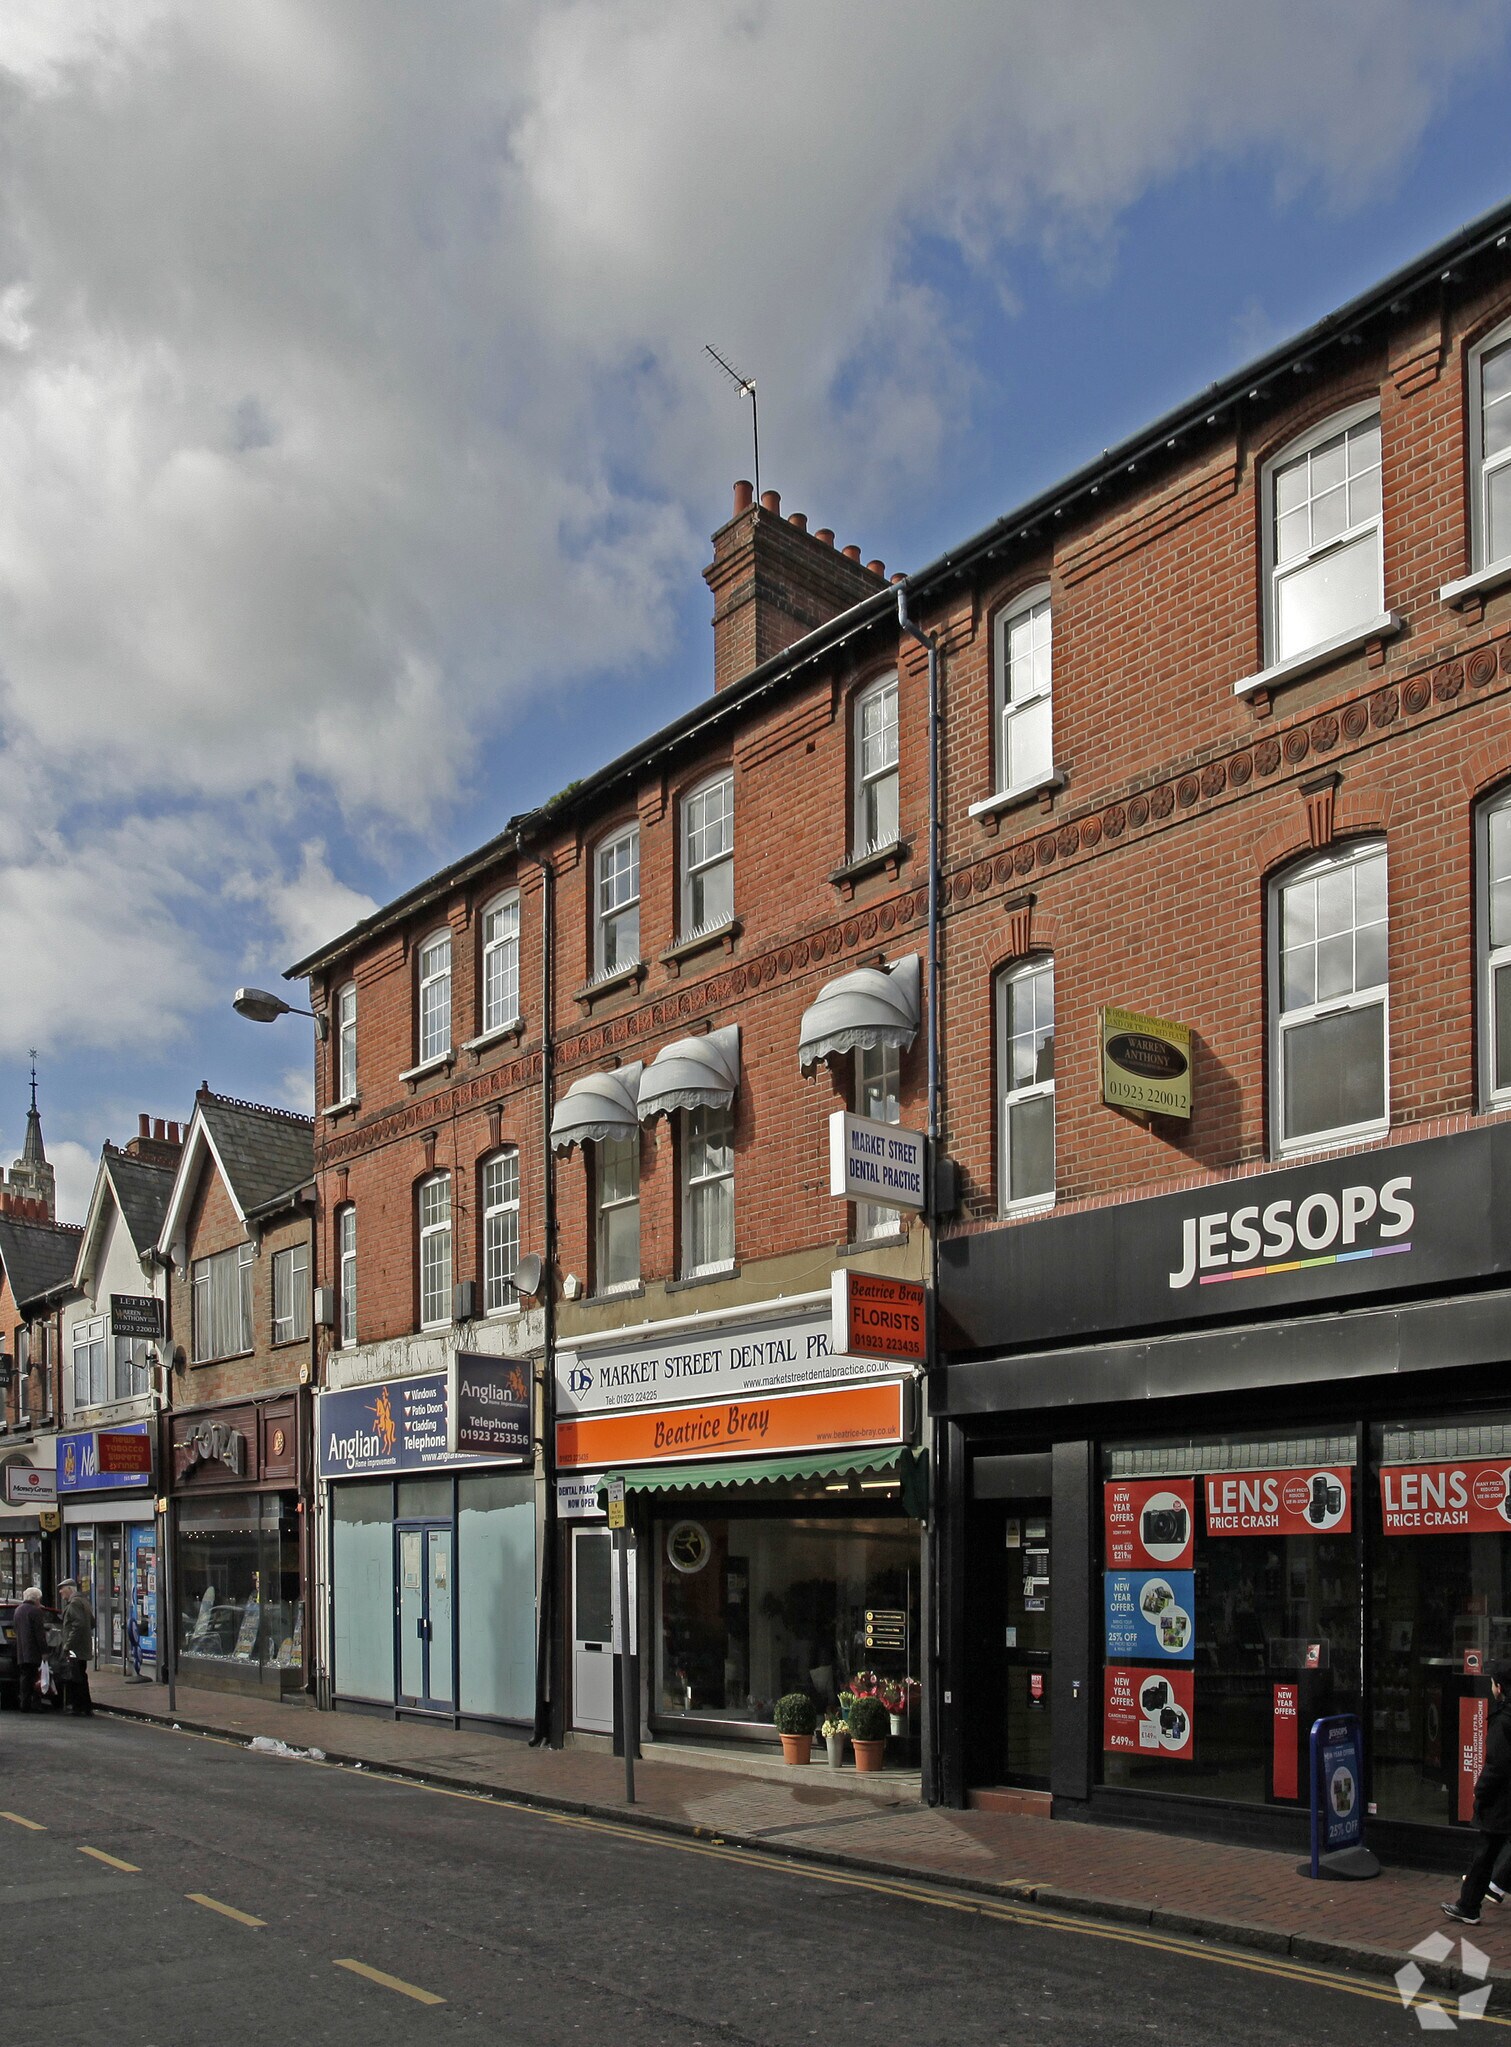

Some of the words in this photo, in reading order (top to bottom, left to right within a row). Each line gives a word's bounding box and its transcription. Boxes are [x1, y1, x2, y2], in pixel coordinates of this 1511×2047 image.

[1108, 1018, 1124, 1027] AND
[1134, 1023, 1149, 1033] TWO
[1155, 1027, 1168, 1037] BED
[1168, 1030, 1186, 1041] FLATS
[1130, 1012, 1160, 1026] BUILDING
[1161, 1019, 1173, 1029] FOR
[1174, 1021, 1188, 1032] SALE
[1127, 1036, 1166, 1054] WARREN
[1124, 1049, 1170, 1066] ANTHONY
[1110, 1081, 1144, 1101] 01923
[1147, 1088, 1186, 1109] 220012
[852, 1130, 885, 1157] MARKET
[888, 1139, 917, 1165] STREET
[849, 1157, 880, 1183] DENTAL
[883, 1165, 920, 1193] PRACTICE
[1169, 1176, 1415, 1289] JESSOPS
[851, 1280, 895, 1299] Beatrice
[898, 1285, 924, 1306] Bray
[120, 1297, 137, 1306] LET
[139, 1299, 153, 1307] BY
[853, 1307, 920, 1332] FLORISTS
[113, 1323, 135, 1332] 01923
[855, 1333, 883, 1348] 01923
[886, 1338, 920, 1353] 223435
[599, 1360, 659, 1388] MARKET
[664, 1350, 723, 1379] STREET
[729, 1339, 798, 1370] DENTAL
[743, 1361, 890, 1388] www.marketstreetdentalpractice.co.uk
[412, 1388, 437, 1400] Windows
[460, 1380, 512, 1404] Anglian
[605, 1395, 615, 1406] Tel:
[616, 1392, 635, 1405] 01923
[635, 1390, 658, 1403] 224225
[412, 1404, 426, 1417] Patio
[426, 1403, 444, 1415] Doors
[412, 1419, 437, 1433] Cladding
[469, 1416, 519, 1431] Telephone
[653, 1413, 720, 1449] Beatrice
[727, 1405, 770, 1437] Bray
[460, 1429, 491, 1441] 01923
[493, 1432, 529, 1445] 253356
[816, 1426, 897, 1441] www.beatrice-bray.co.uk
[328, 1430, 380, 1469] Anglian
[404, 1433, 446, 1452] Telephone
[355, 1459, 367, 1468] Home
[367, 1457, 397, 1468] improvements
[13, 1485, 53, 1493] MoneyGram
[559, 1486, 578, 1497] DENTAL
[1208, 1478, 1279, 1514] LENS
[1384, 1470, 1468, 1511] LENS
[567, 1498, 580, 1509] NOW
[580, 1498, 595, 1508] OPEN
[1113, 1493, 1130, 1502] NEW
[1112, 1503, 1131, 1512] YEAR
[1109, 1513, 1134, 1522] OFFERS
[1210, 1516, 1239, 1529] PRICE
[1241, 1515, 1279, 1528] CRASH
[1386, 1513, 1421, 1527] PRICE
[1424, 1510, 1469, 1525] CRASH
[1114, 1583, 1130, 1592] NEW
[1113, 1593, 1131, 1602] YEAR
[1110, 1603, 1135, 1612] OFFERS
[1108, 1632, 1123, 1641] 25%
[1124, 1633, 1138, 1641] OFF
[1114, 1677, 1130, 1686] NEW
[1113, 1687, 1131, 1697] YEAR
[1277, 1691, 1292, 1699] NEW
[1110, 1696, 1134, 1707] OFFERS
[1277, 1699, 1293, 1707] YEAR
[1274, 1707, 1296, 1716] OFFERS
[1328, 1726, 1348, 1740] JESSOPS
[1463, 1745, 1473, 1772] FREE
[1329, 1824, 1344, 1838] 25%
[1345, 1819, 1358, 1834] OFF
